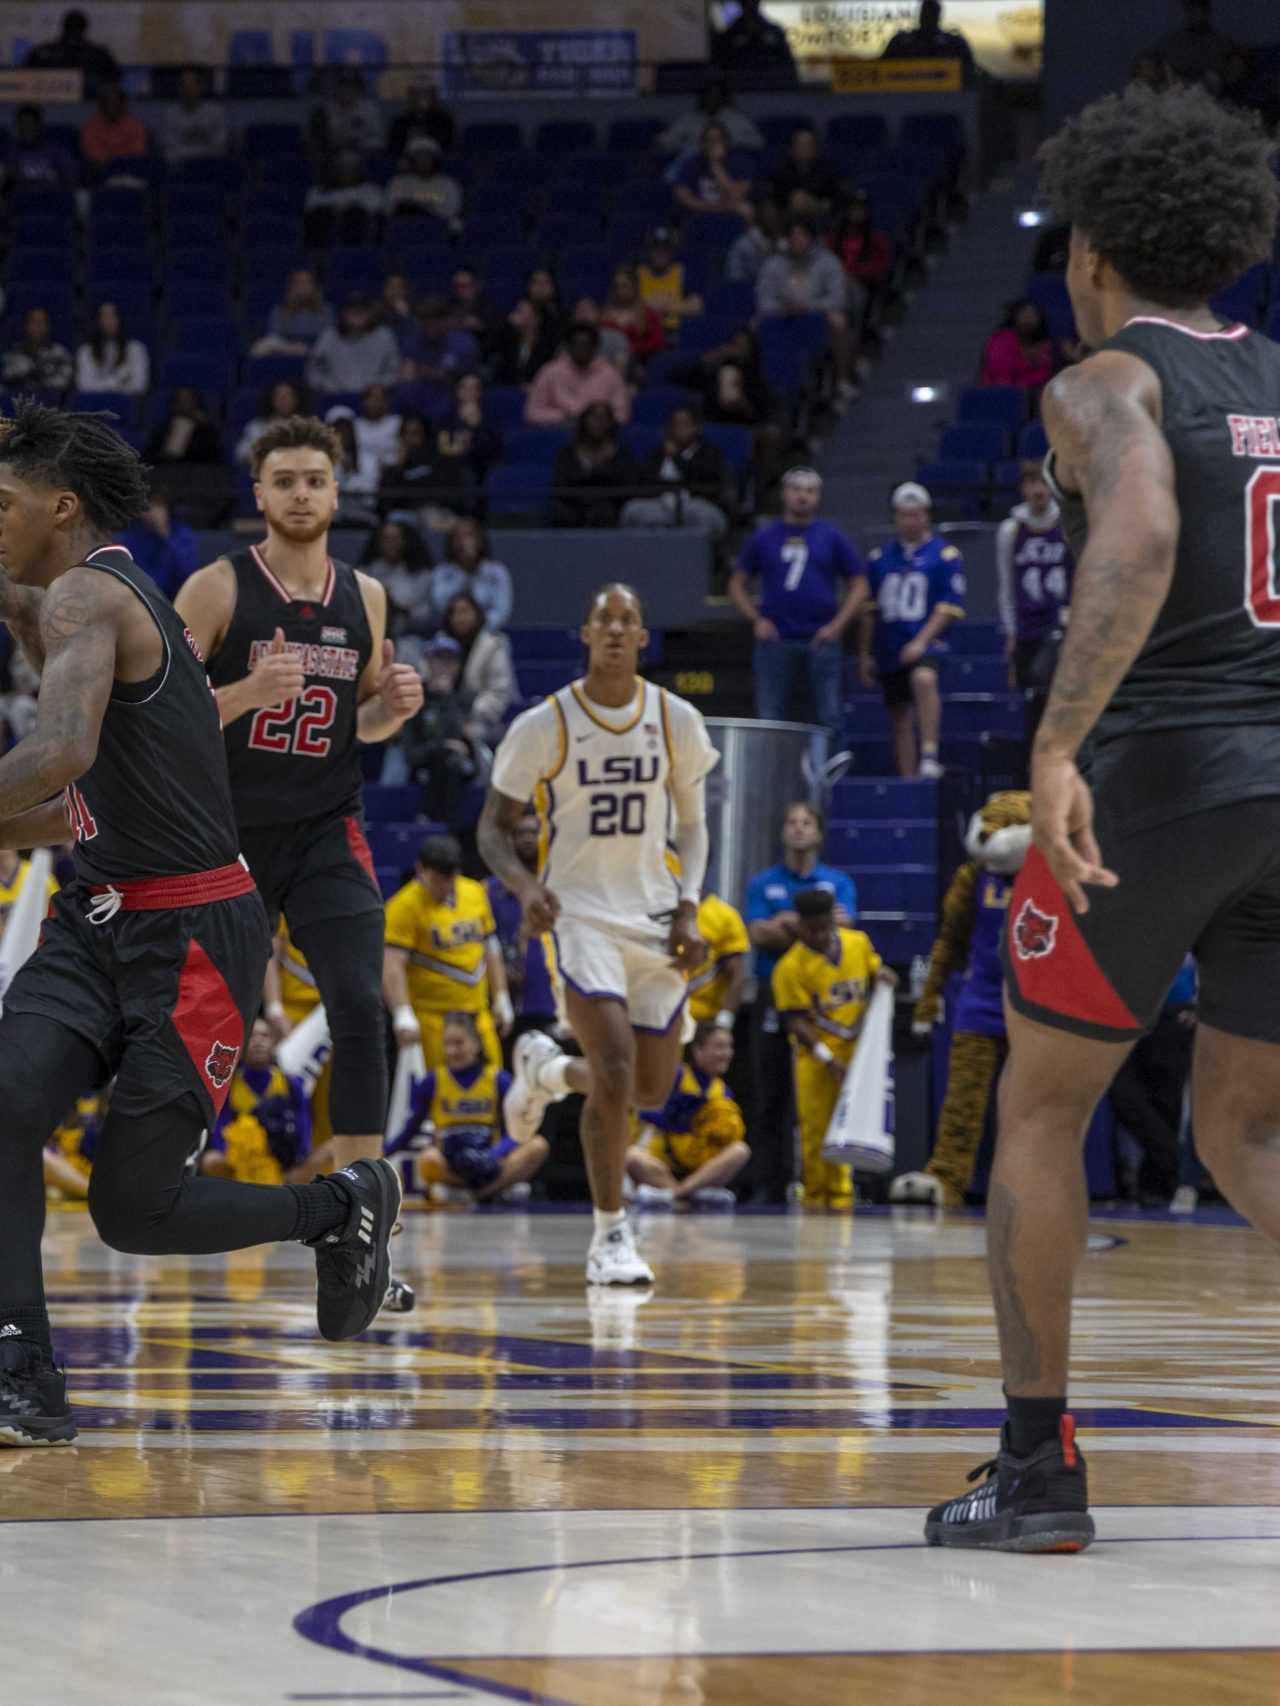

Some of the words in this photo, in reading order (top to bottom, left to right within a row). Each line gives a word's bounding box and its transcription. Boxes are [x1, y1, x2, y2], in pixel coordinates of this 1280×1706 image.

[781, 541, 808, 591] 7
[248, 685, 337, 757] 22
[578, 756, 659, 785] LSU
[590, 793, 646, 835] 20
[431, 920, 482, 950] LSU
[441, 1098, 494, 1114] LSU
